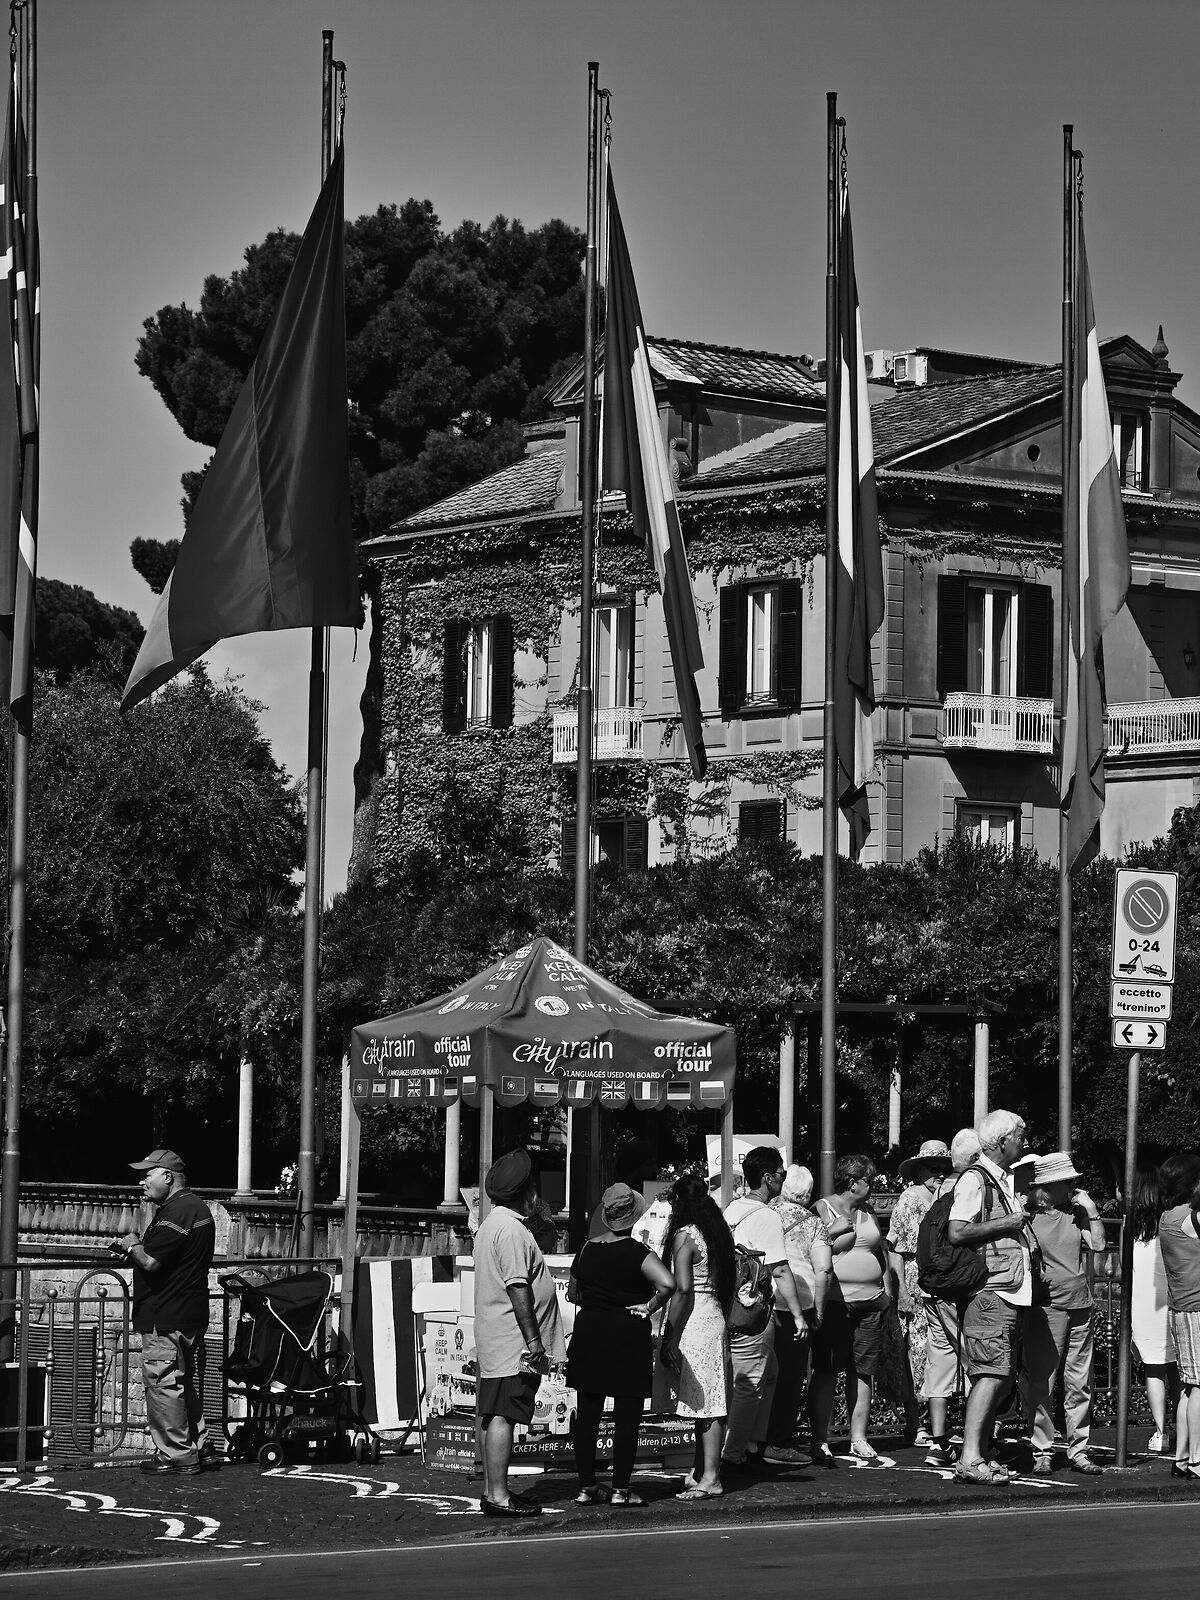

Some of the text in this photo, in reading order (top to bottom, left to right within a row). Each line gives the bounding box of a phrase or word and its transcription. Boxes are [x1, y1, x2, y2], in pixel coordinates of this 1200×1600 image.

[1128, 938, 1160, 953] 0-24
[1119, 988, 1162, 999] eccetto
[597, 1003, 632, 1016] TALY
[434, 1035, 471, 1053] official
[654, 1041, 712, 1058] official
[447, 1053, 471, 1067] tour
[677, 1058, 712, 1072] tour
[567, 1070, 661, 1079] LANGUAGES USED ON BOARD
[513, 1444, 537, 1453] CKETS
[539, 1442, 559, 1452] HERE
[596, 1438, 614, 1450] 6,0
[637, 1438, 659, 1447] ildren
[660, 1435, 680, 1446] (2-12)
